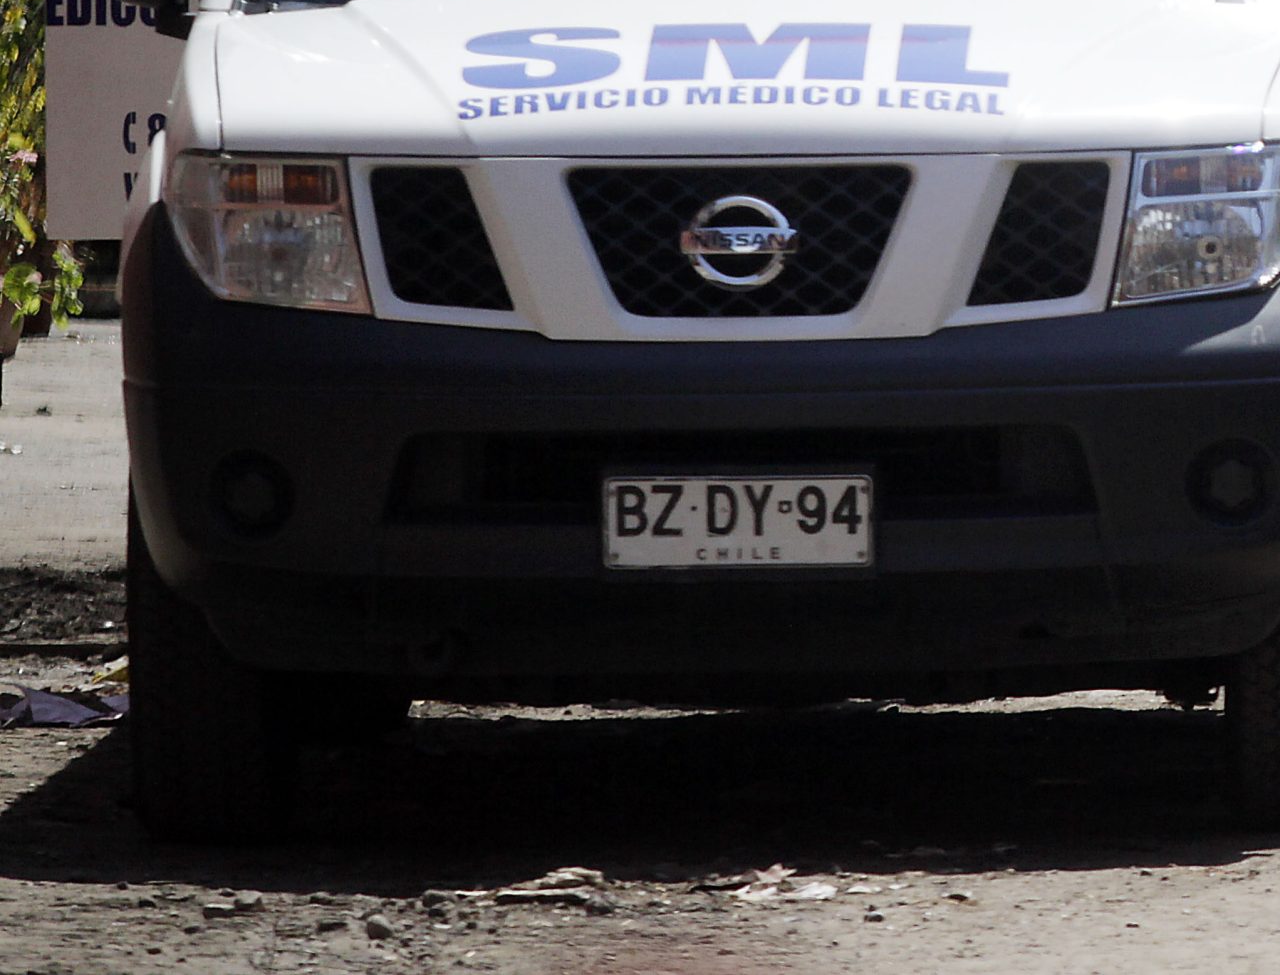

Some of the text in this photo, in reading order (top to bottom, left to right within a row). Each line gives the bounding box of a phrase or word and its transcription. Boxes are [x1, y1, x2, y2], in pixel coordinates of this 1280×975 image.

[461, 22, 1010, 90] SML
[457, 81, 1006, 121] SERVICIO MÉDICO LEGAL
[696, 229, 786, 250] NISSAN
[695, 546, 782, 561] CHILE
